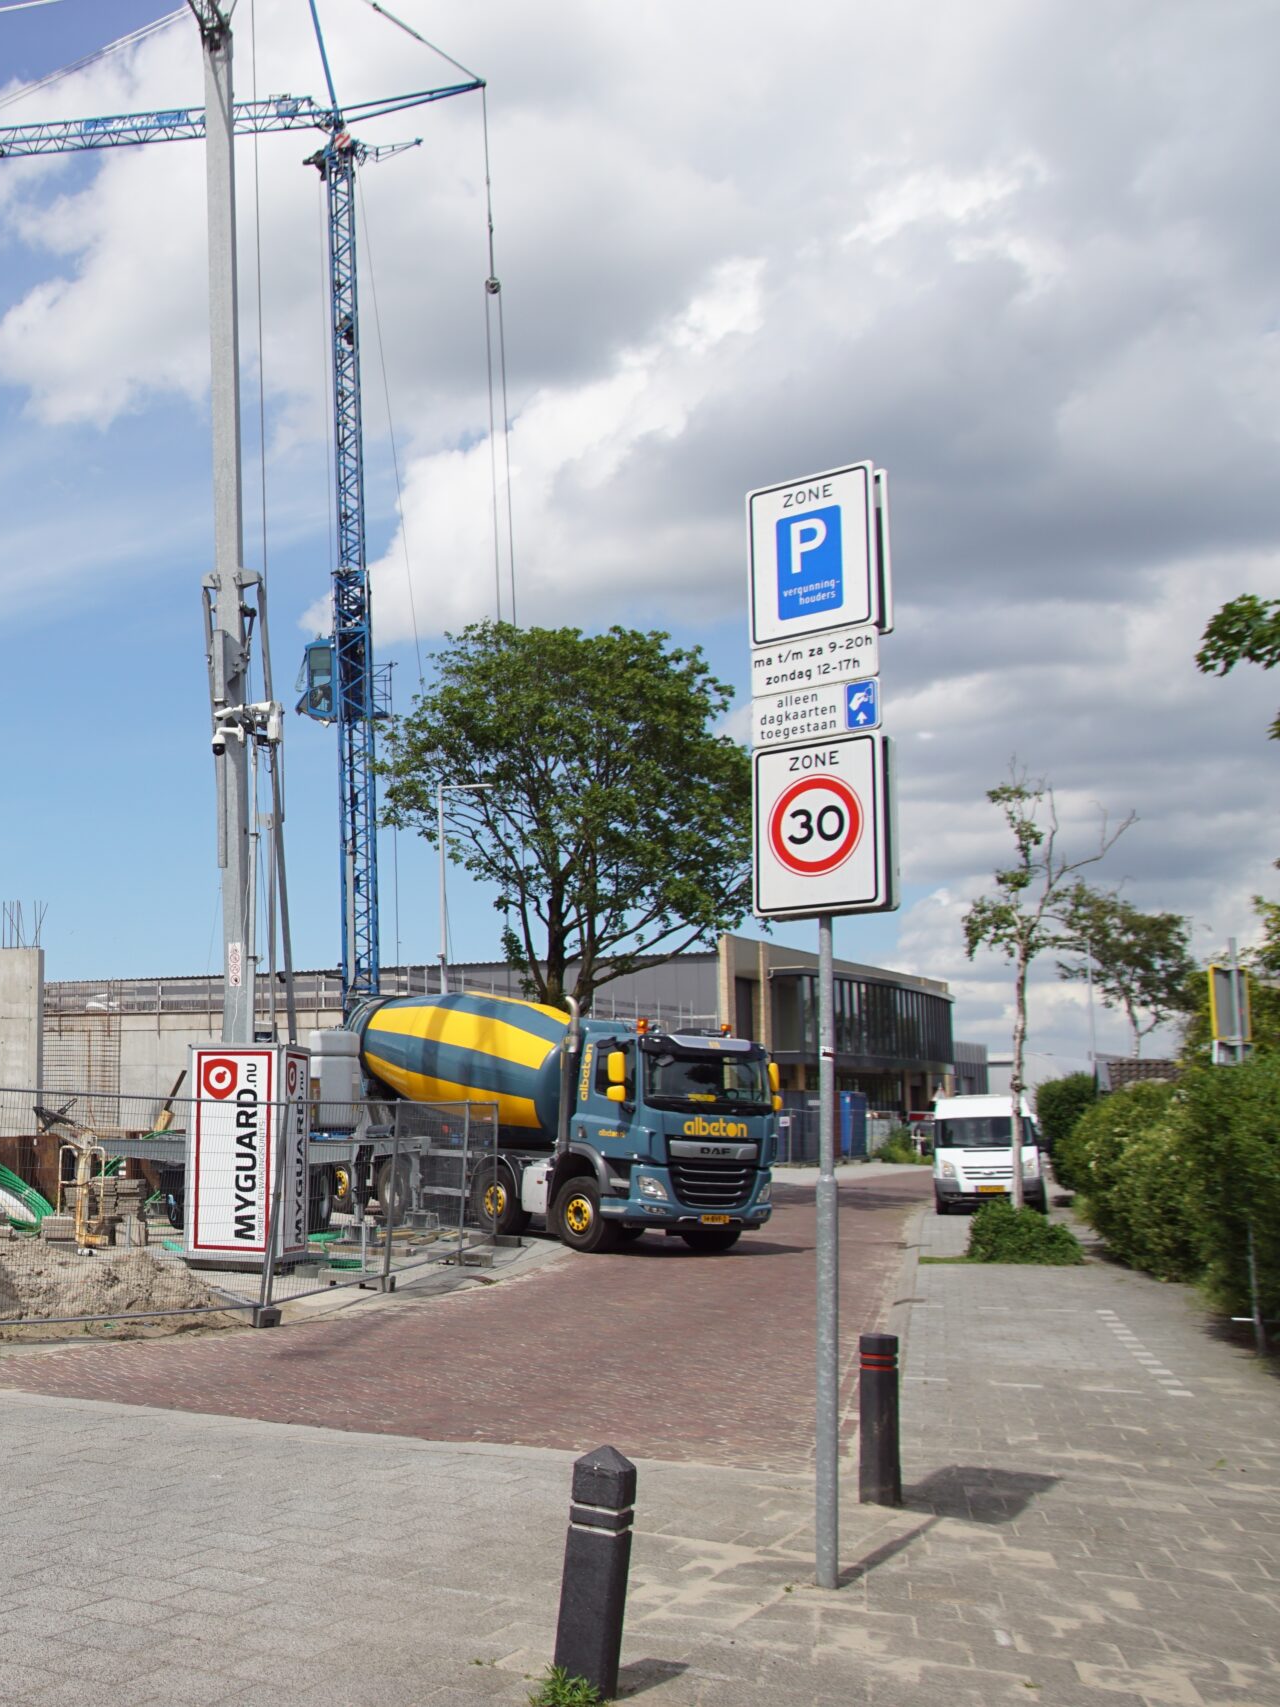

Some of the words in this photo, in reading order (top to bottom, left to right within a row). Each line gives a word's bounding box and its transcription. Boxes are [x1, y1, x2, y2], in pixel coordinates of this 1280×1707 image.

[783, 484, 833, 508] ZONE
[790, 518, 827, 574] P
[783, 579, 840, 598] vergunning-
[799, 591, 836, 605] houders
[754, 657, 773, 668] ma
[778, 649, 803, 664] t/m
[808, 647, 823, 658] za
[829, 635, 873, 653] 9-20h
[766, 669, 812, 686] zondag
[817, 657, 860, 675] 12-17h
[777, 693, 818, 708] alleen
[760, 704, 837, 726] dagkaarten
[760, 719, 837, 740] toegestaan
[789, 751, 839, 771] ZONE
[788, 805, 844, 844] 30
[580, 1044, 593, 1101] albeton
[684, 1116, 747, 1137] albeton
[234, 1063, 258, 1240] MYGUARD.nu
[700, 1147, 731, 1155] DAF
[257, 1204, 265, 1242] MOBIELE
